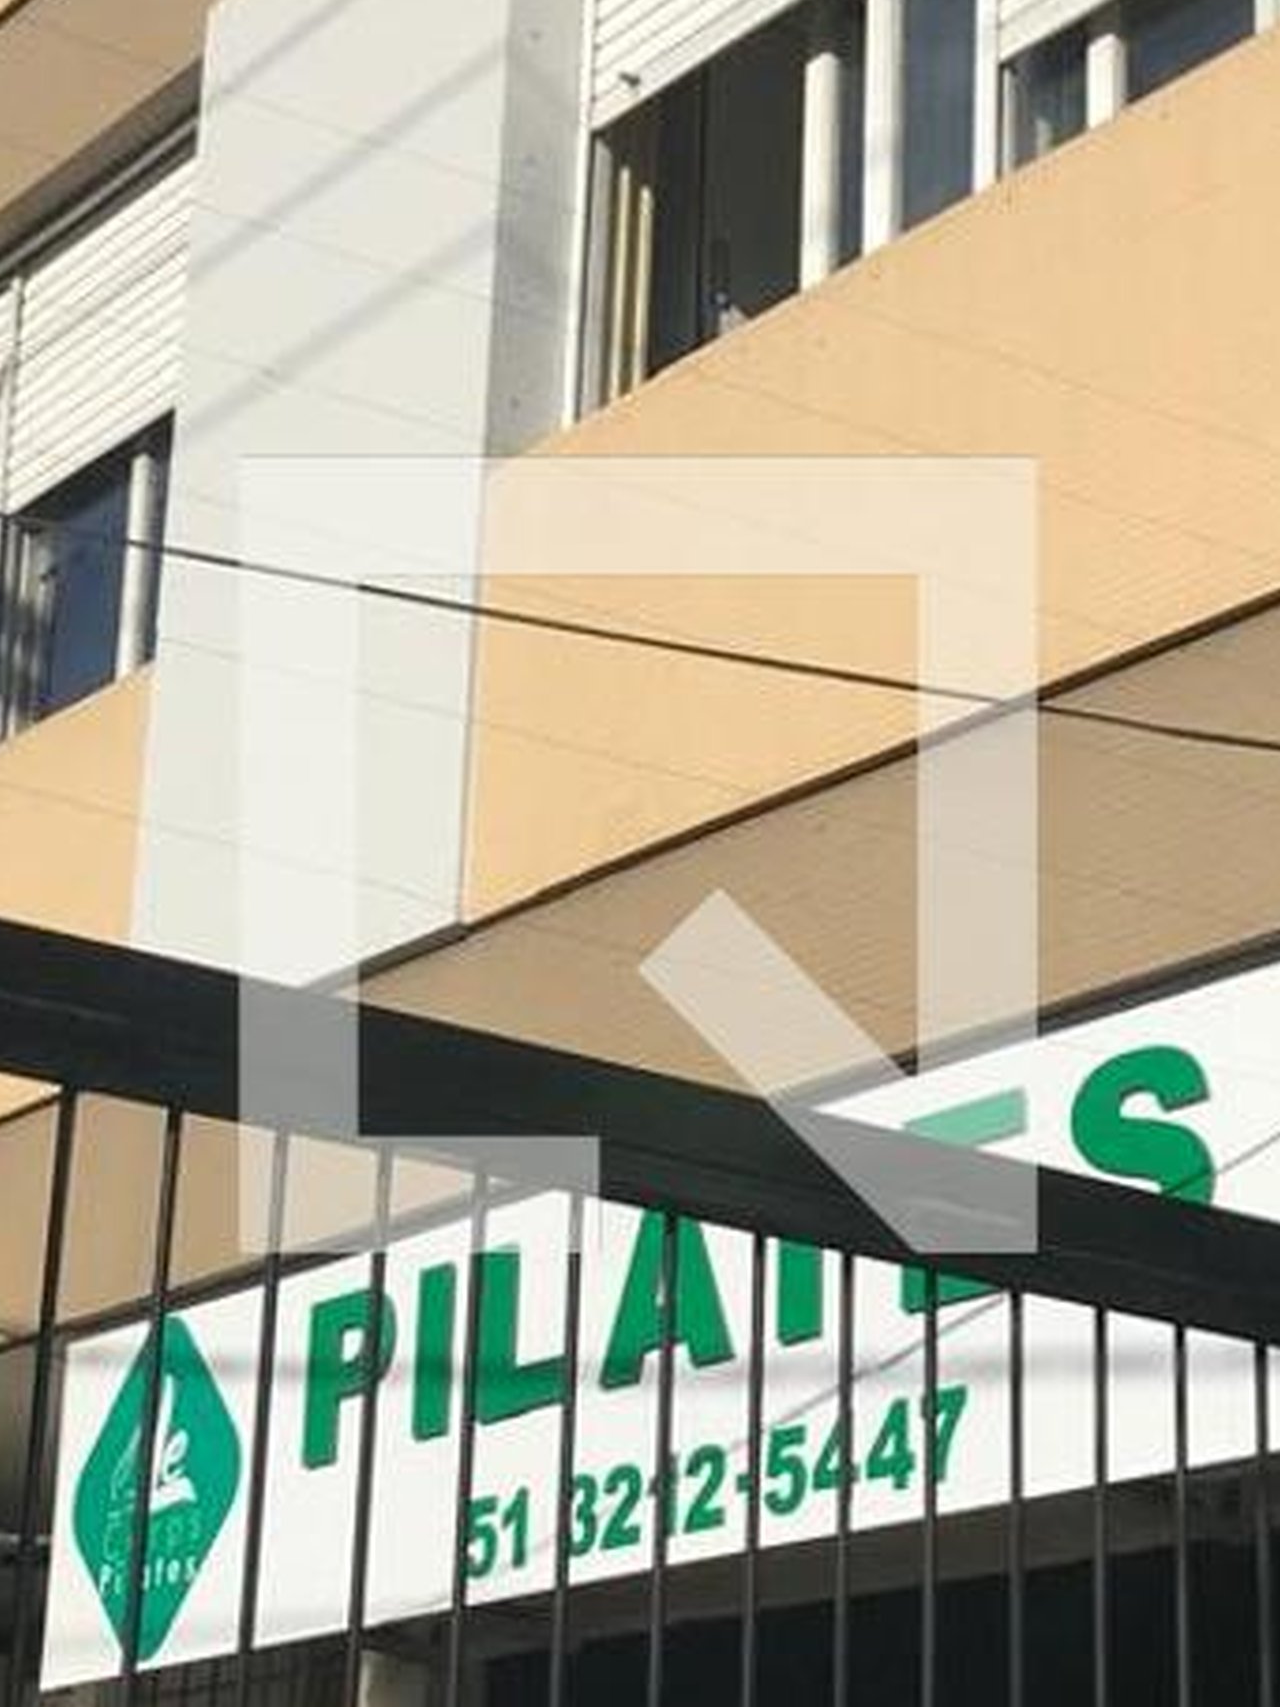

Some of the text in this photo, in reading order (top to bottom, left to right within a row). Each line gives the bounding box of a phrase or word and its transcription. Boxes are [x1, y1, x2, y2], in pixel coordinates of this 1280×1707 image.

[465, 1384, 969, 1579] 51 3212-5447
[102, 1505, 203, 1562] Cps
[98, 1555, 200, 1595] Pites
